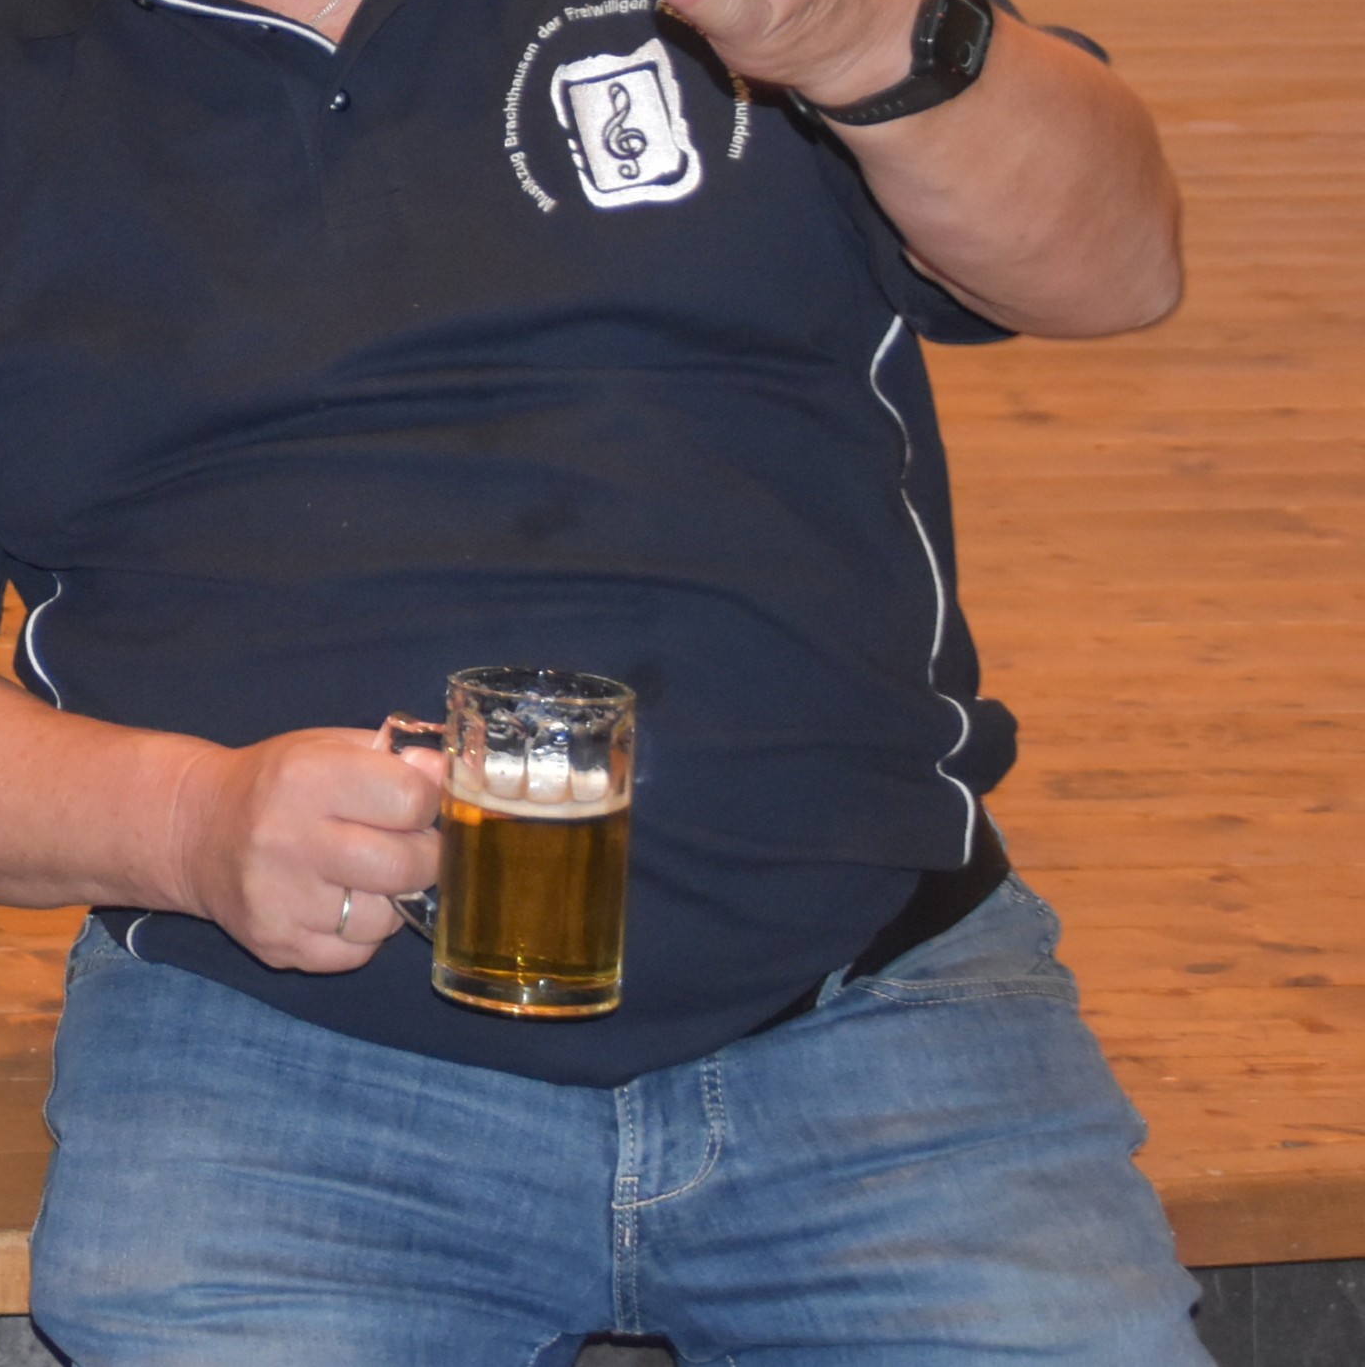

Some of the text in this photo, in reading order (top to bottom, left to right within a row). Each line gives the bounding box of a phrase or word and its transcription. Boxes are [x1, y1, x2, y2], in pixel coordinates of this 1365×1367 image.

[536, 15, 564, 40] der
[503, 41, 539, 149] Brachthausen
[509, 150, 557, 214] Musikzug
